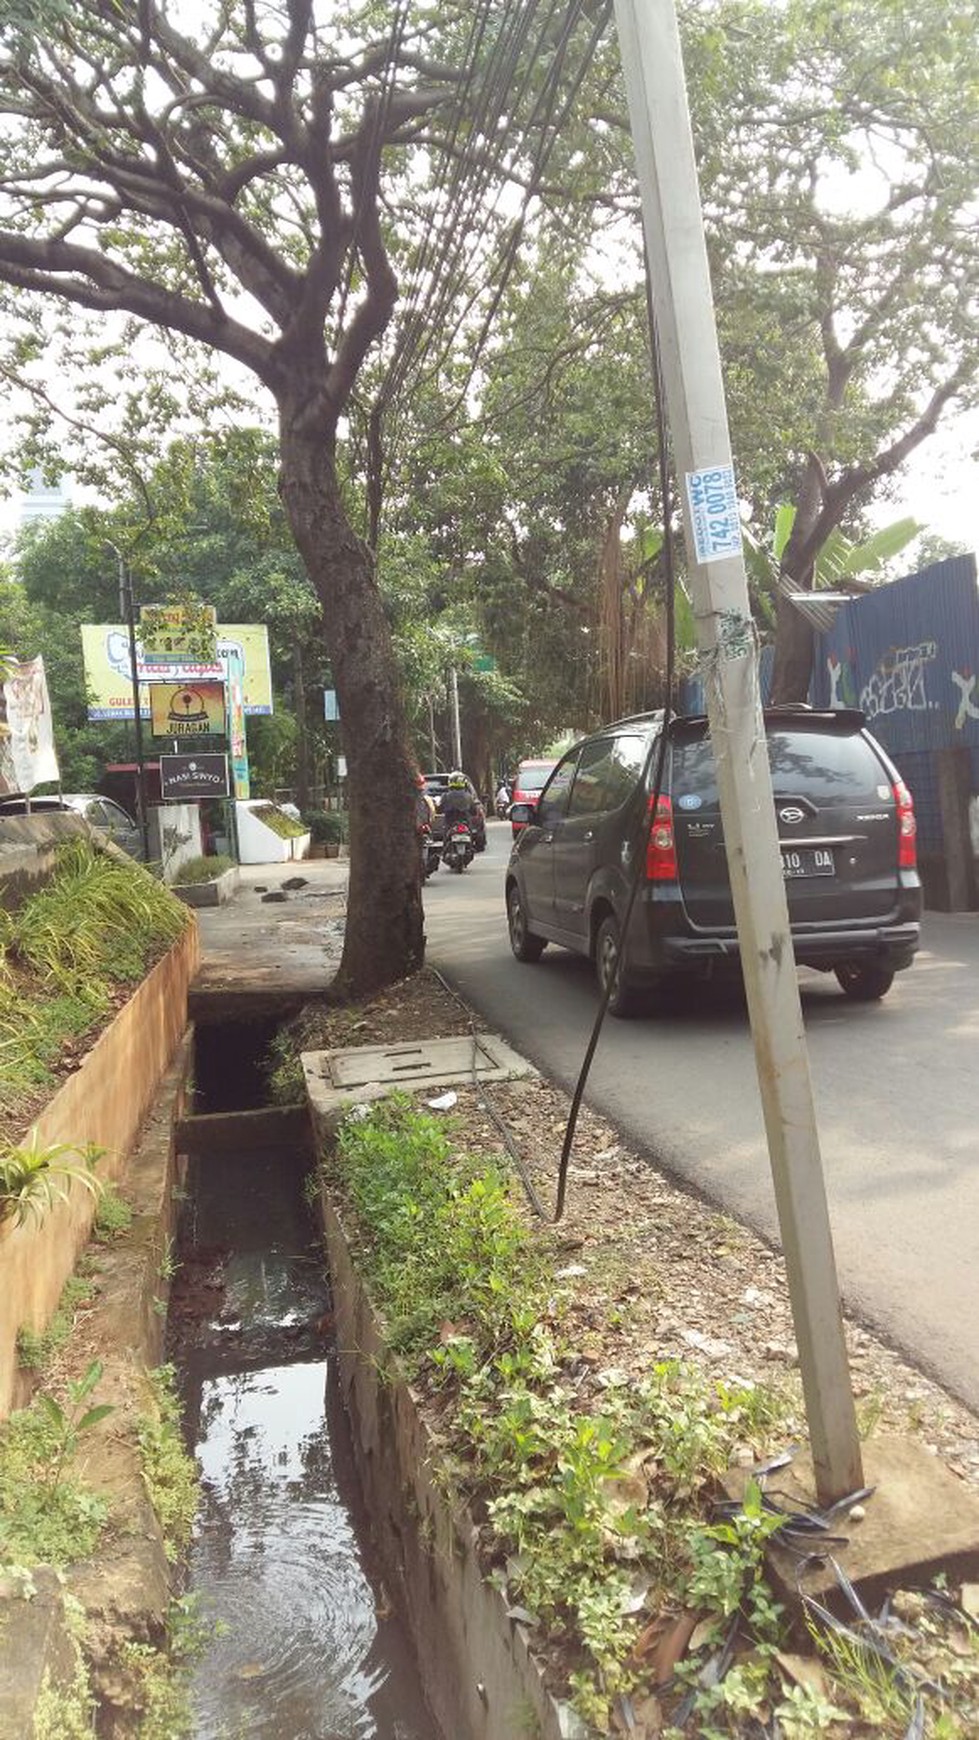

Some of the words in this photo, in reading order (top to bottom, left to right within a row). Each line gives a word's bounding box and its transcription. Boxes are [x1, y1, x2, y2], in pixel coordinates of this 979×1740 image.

[689, 474, 704, 505] WC
[702, 470, 726, 515] 0078
[708, 516, 731, 551] 742
[166, 722, 210, 735] JURAGAN
[169, 772, 190, 785] NASI
